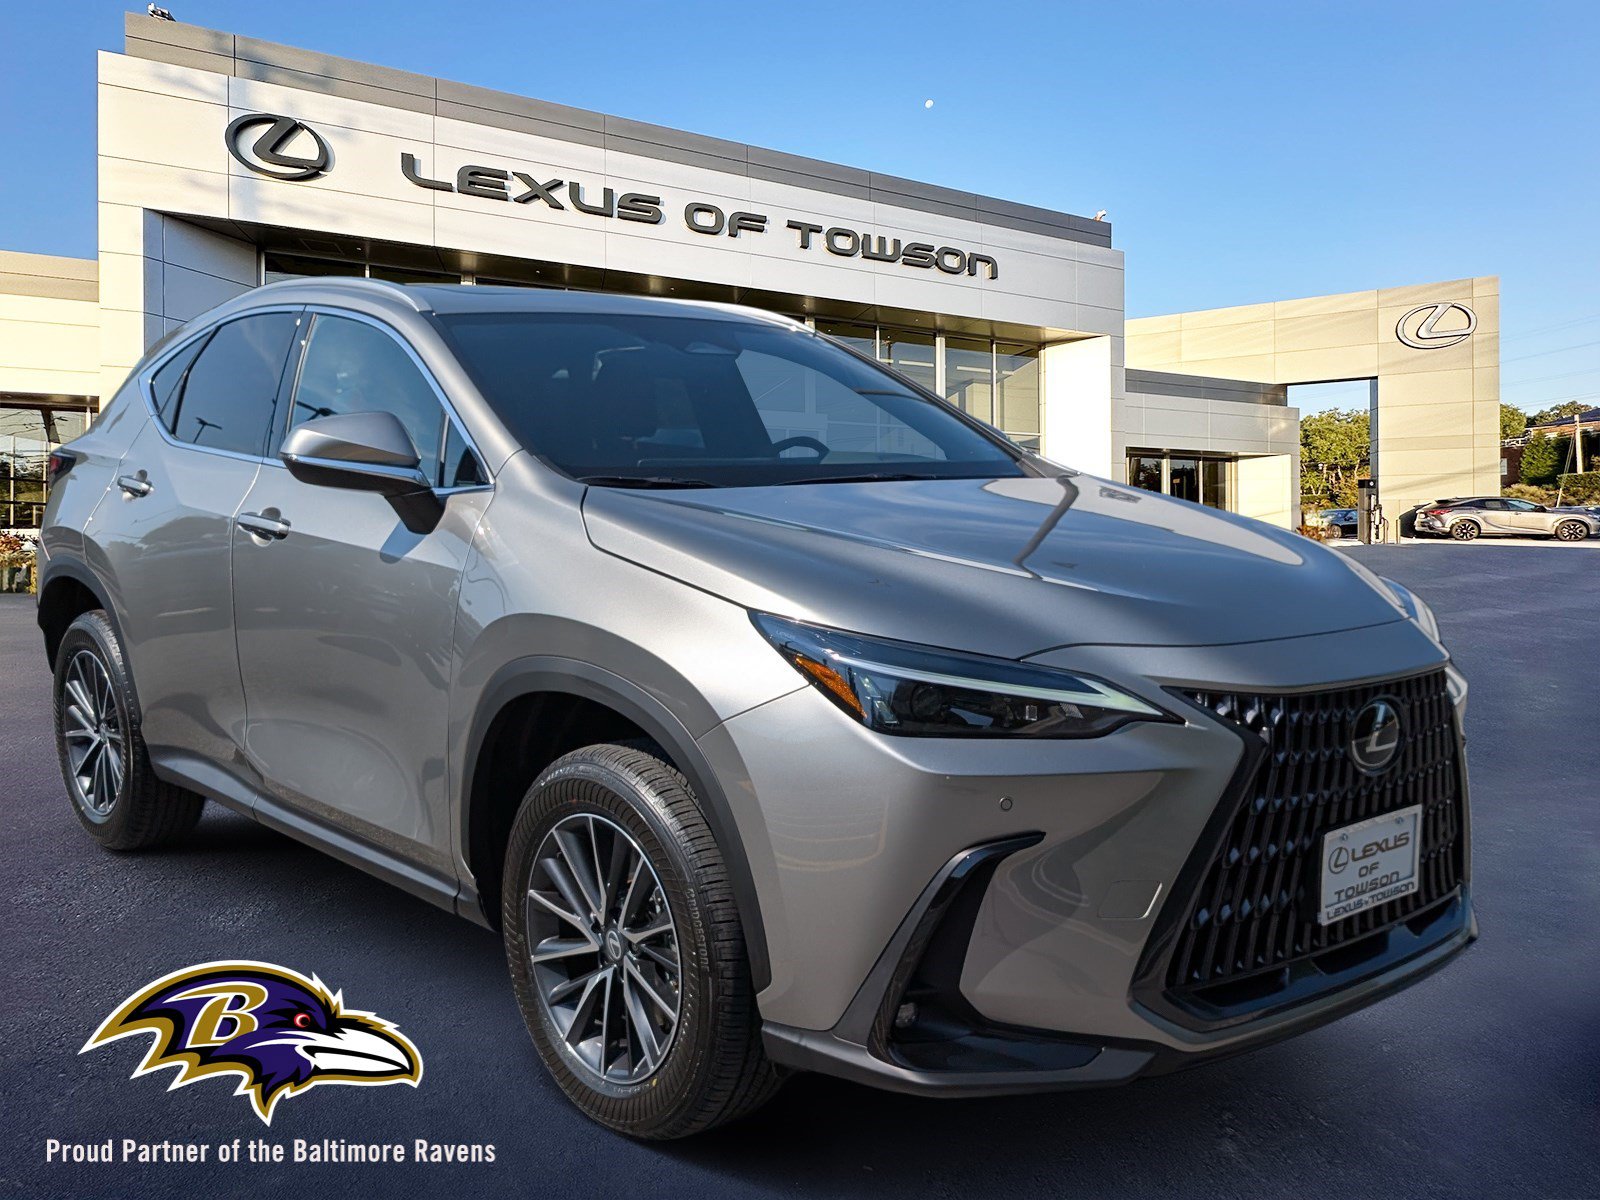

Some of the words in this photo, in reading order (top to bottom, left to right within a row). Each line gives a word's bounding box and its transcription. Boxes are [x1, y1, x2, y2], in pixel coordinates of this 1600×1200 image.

[401, 152, 663, 225] LEXUS
[684, 202, 767, 238] OF
[786, 219, 999, 280] TOWSON
[1351, 831, 1410, 862] LEXUS
[1358, 861, 1379, 878] OF
[1326, 898, 1364, 920] LEXUS
[1369, 881, 1415, 905] TOWSON
[1334, 871, 1400, 902] TOWSON
